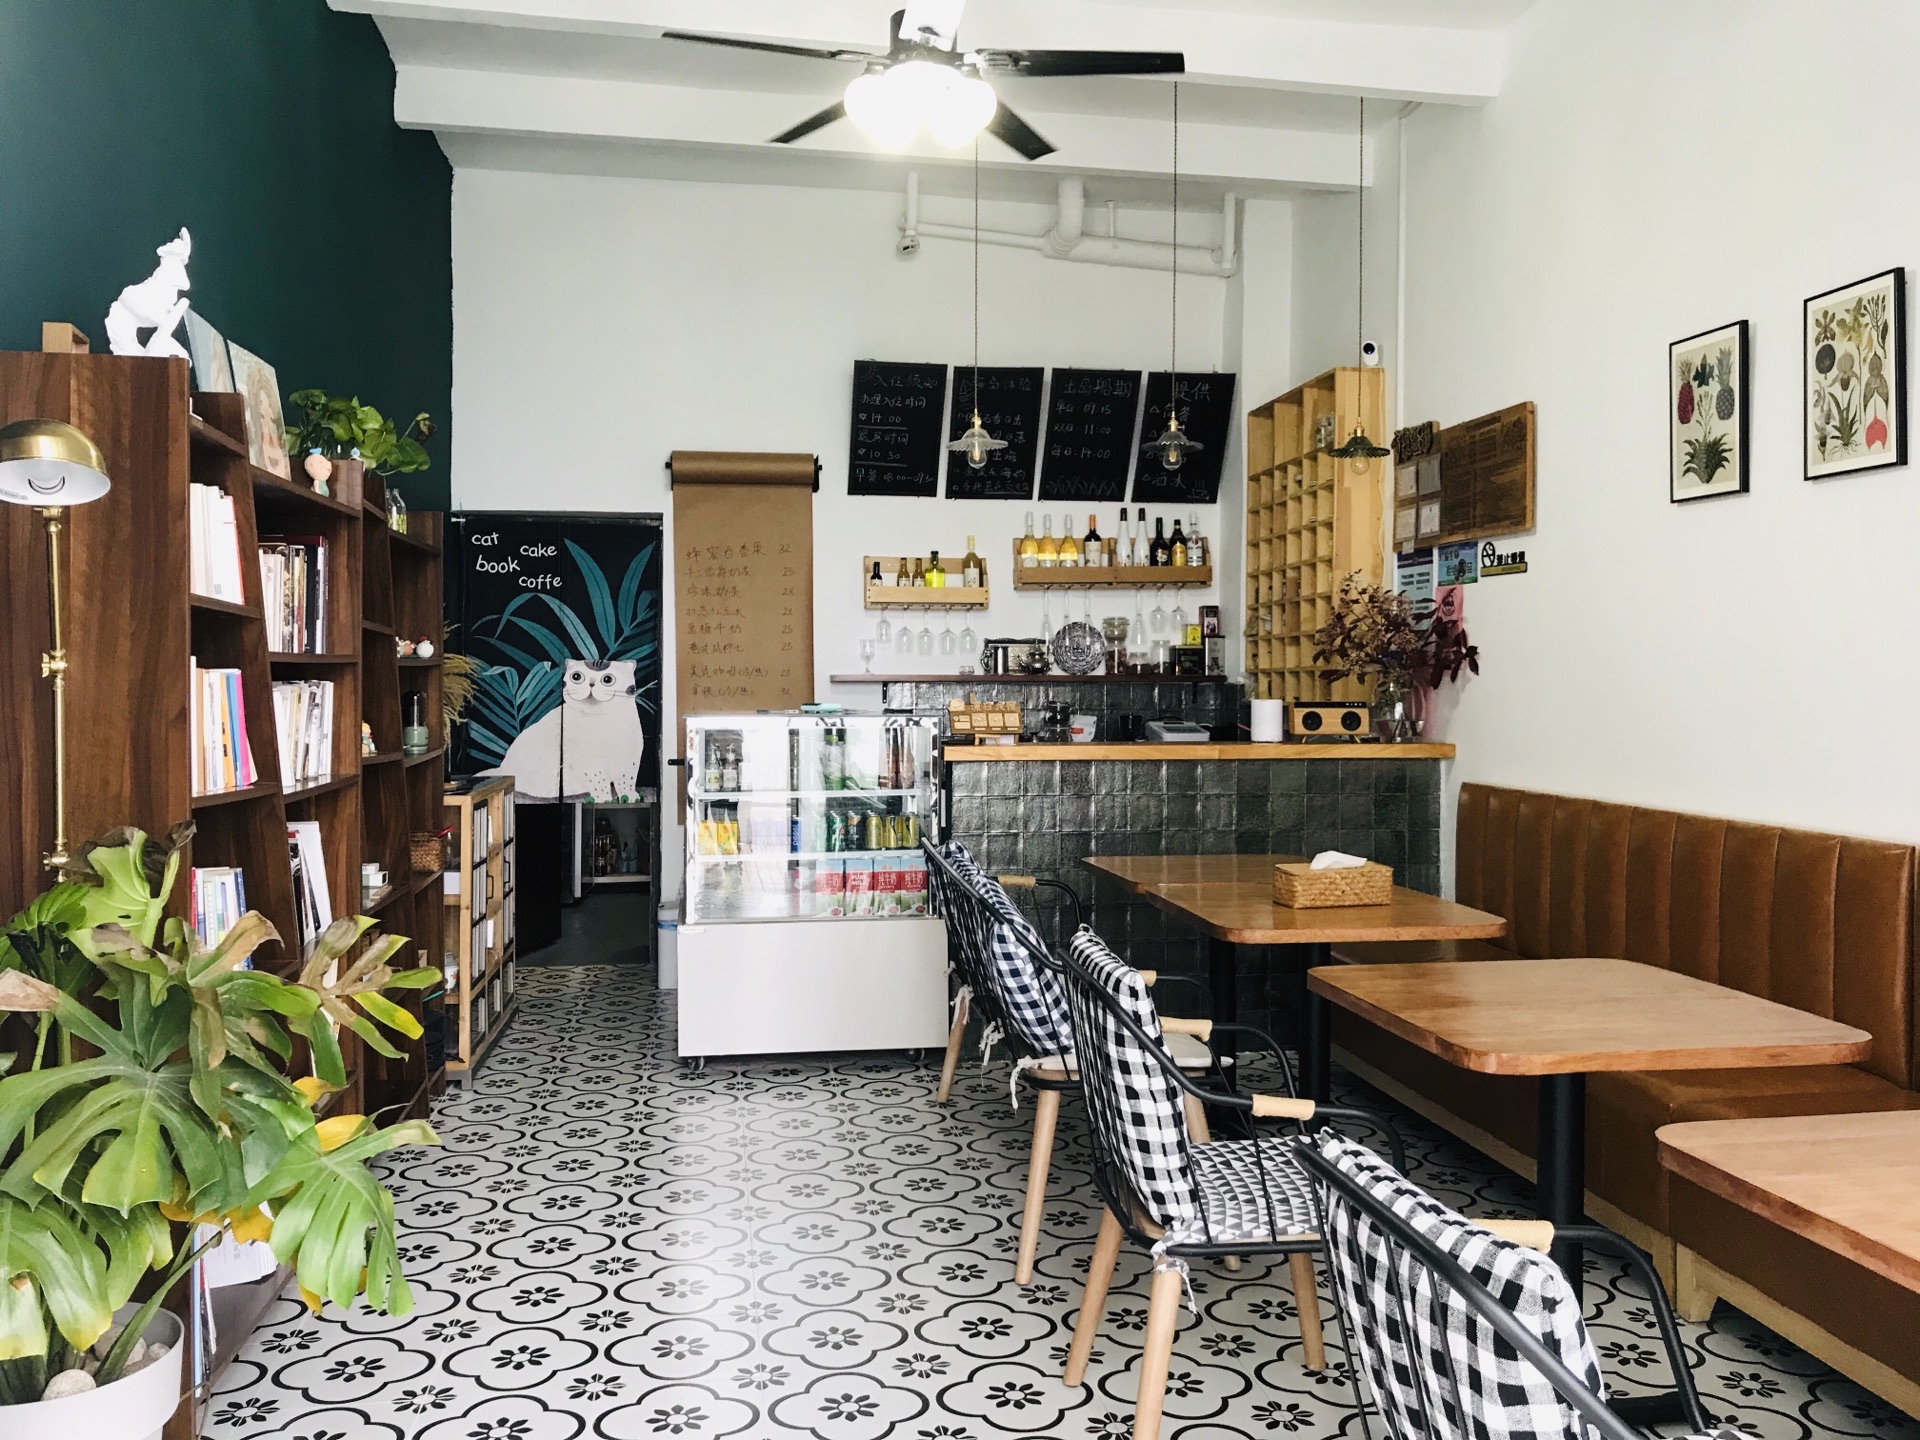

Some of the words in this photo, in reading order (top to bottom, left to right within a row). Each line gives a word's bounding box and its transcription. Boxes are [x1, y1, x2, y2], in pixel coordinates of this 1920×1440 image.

[873, 374, 938, 389] 入住须知
[1063, 376, 1132, 397] 出岛船期
[1175, 381, 1211, 401] 提供
[860, 394, 927, 408] 办理入住时间
[1152, 472, 1186, 488] 酒水
[471, 531, 499, 546] cat
[520, 542, 558, 557] cake
[475, 554, 521, 573] book
[518, 573, 562, 590] coffe
